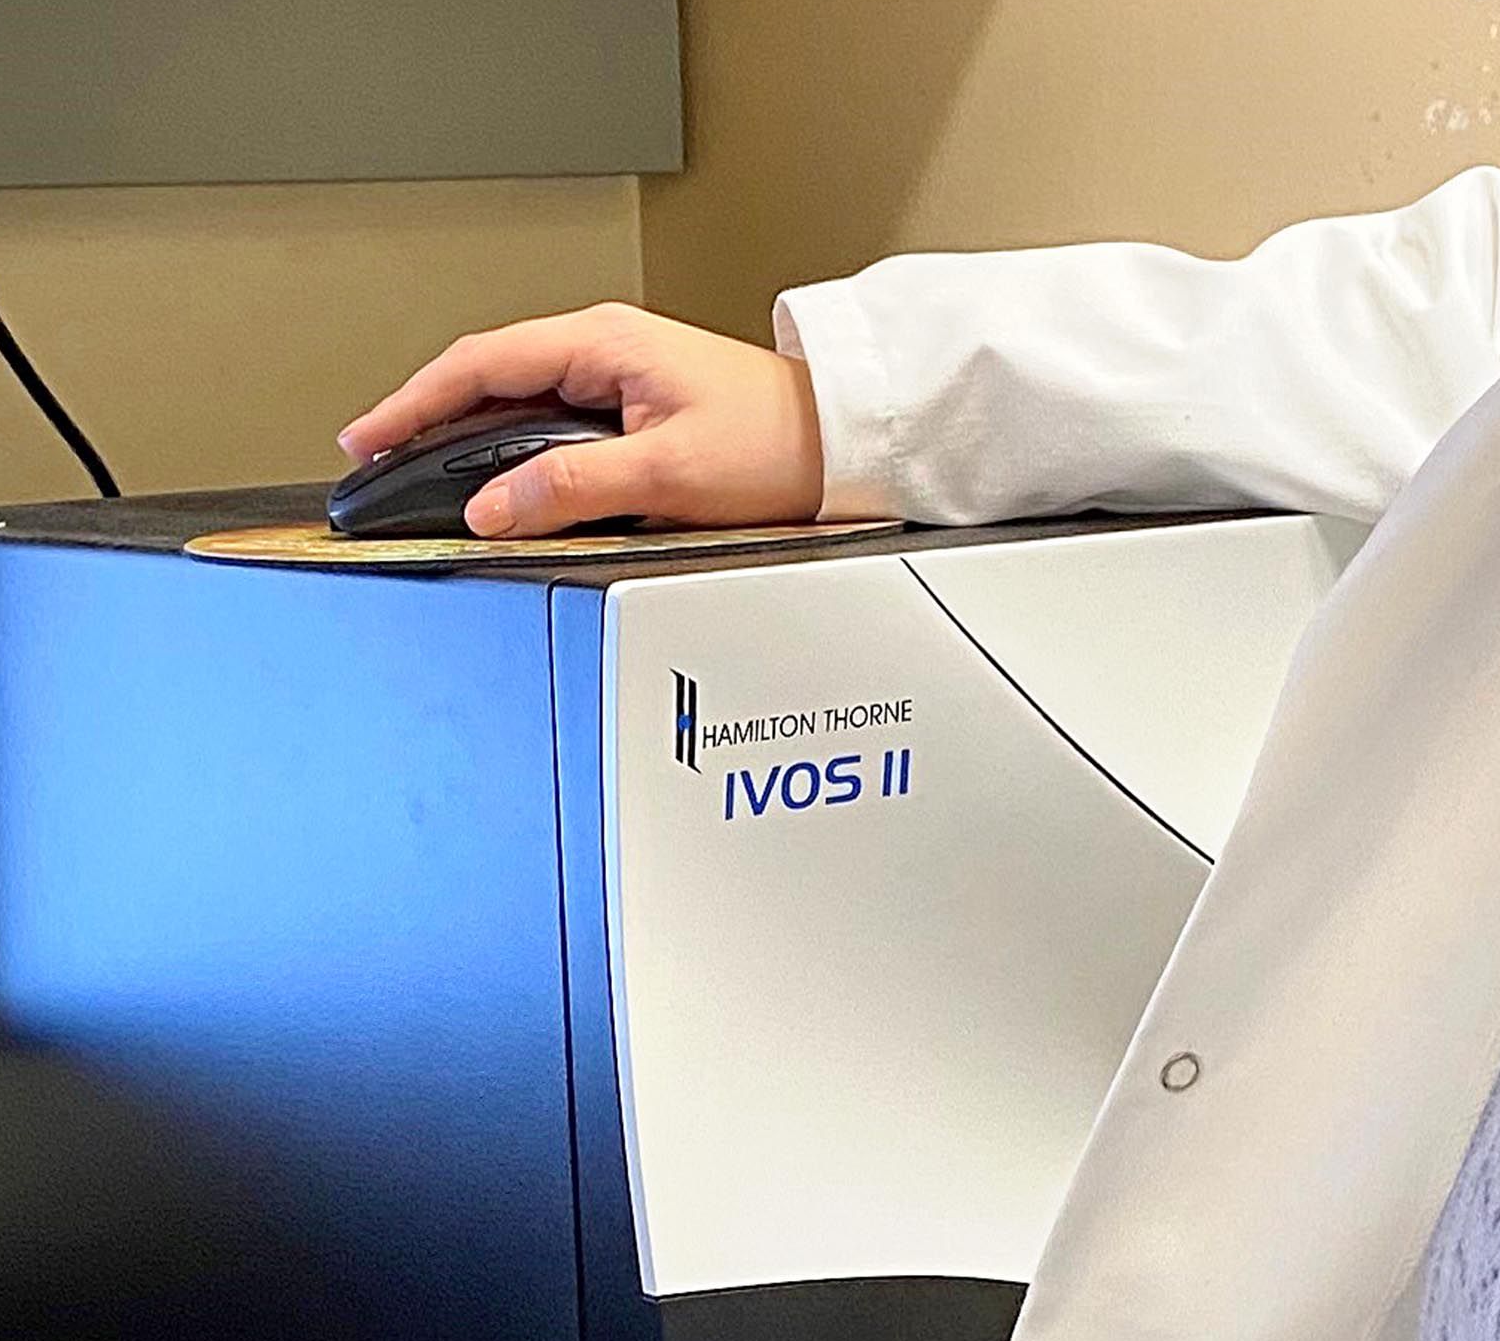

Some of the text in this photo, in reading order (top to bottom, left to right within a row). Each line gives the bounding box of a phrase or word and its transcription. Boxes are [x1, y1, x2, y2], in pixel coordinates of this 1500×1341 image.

[702, 699, 913, 750] HAMILTON THORNE
[724, 749, 911, 821] IVOS II
